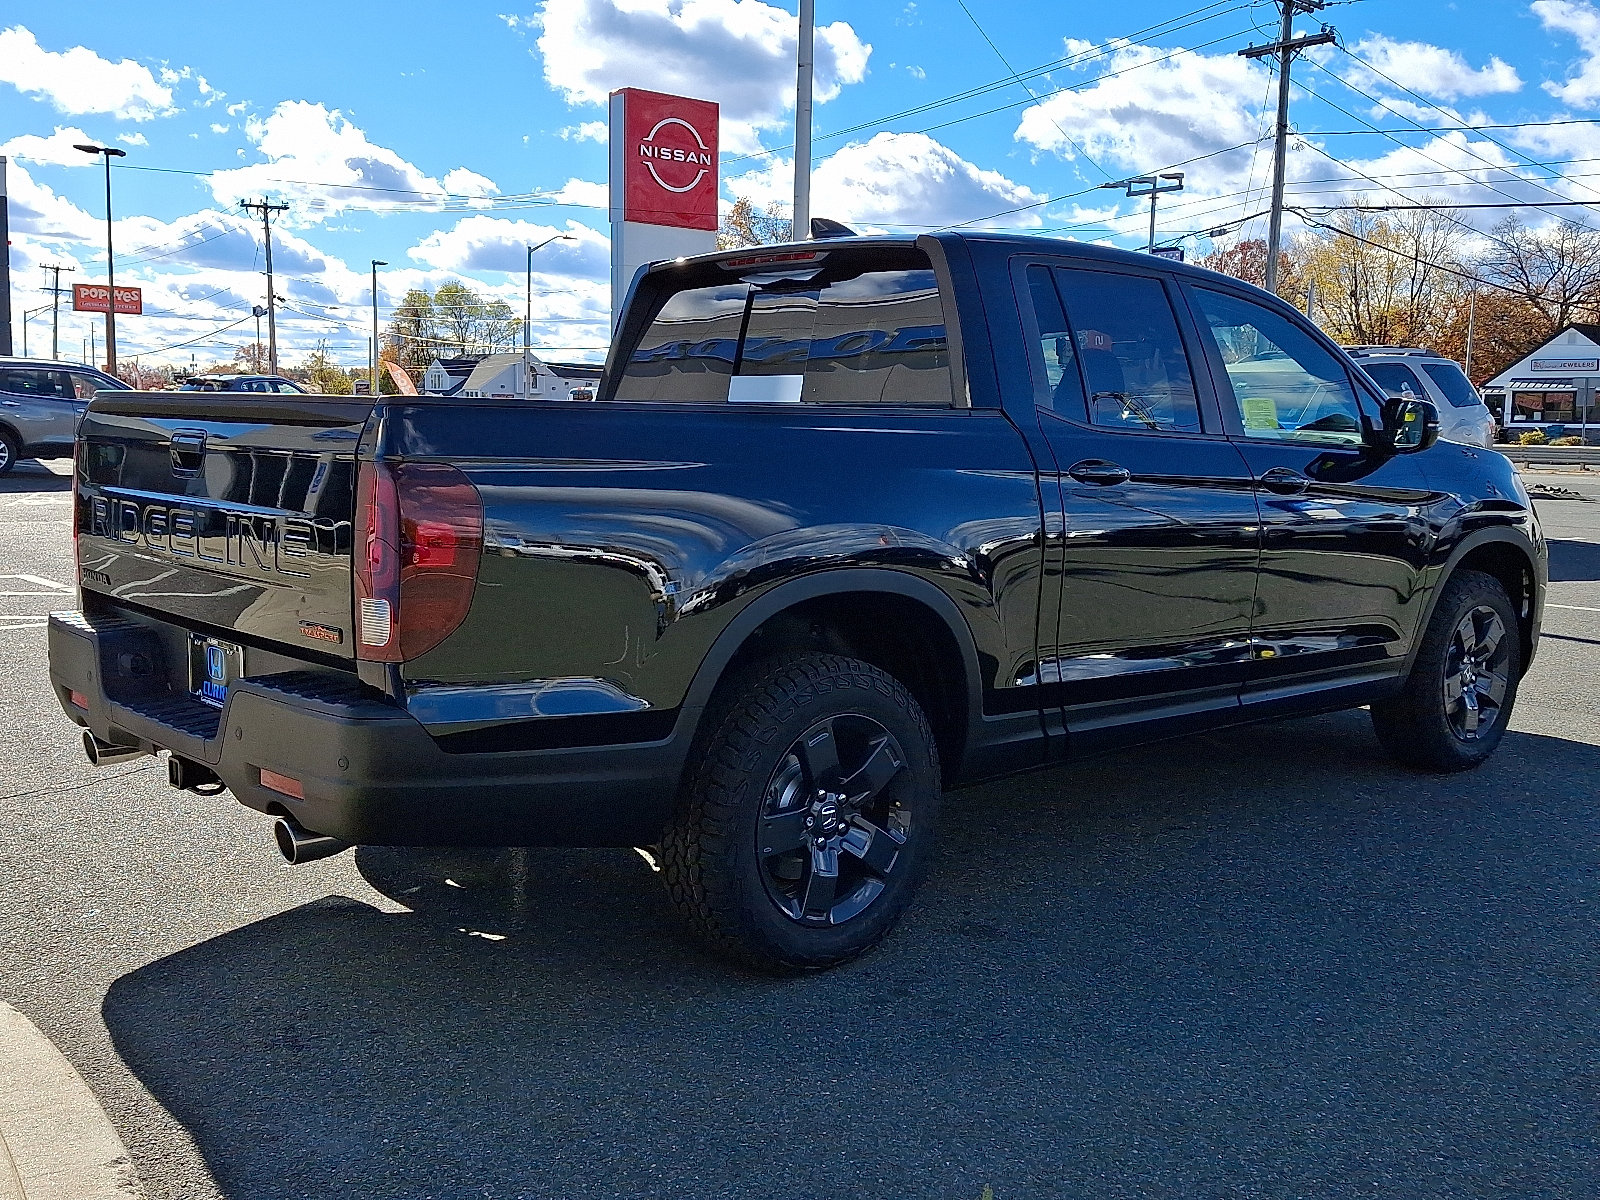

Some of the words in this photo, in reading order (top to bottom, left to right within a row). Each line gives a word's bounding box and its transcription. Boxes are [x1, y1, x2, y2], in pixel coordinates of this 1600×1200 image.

[640, 144, 711, 166] NISSAN
[92, 495, 311, 578] RIDGELINE
[82, 567, 111, 585] HONDA
